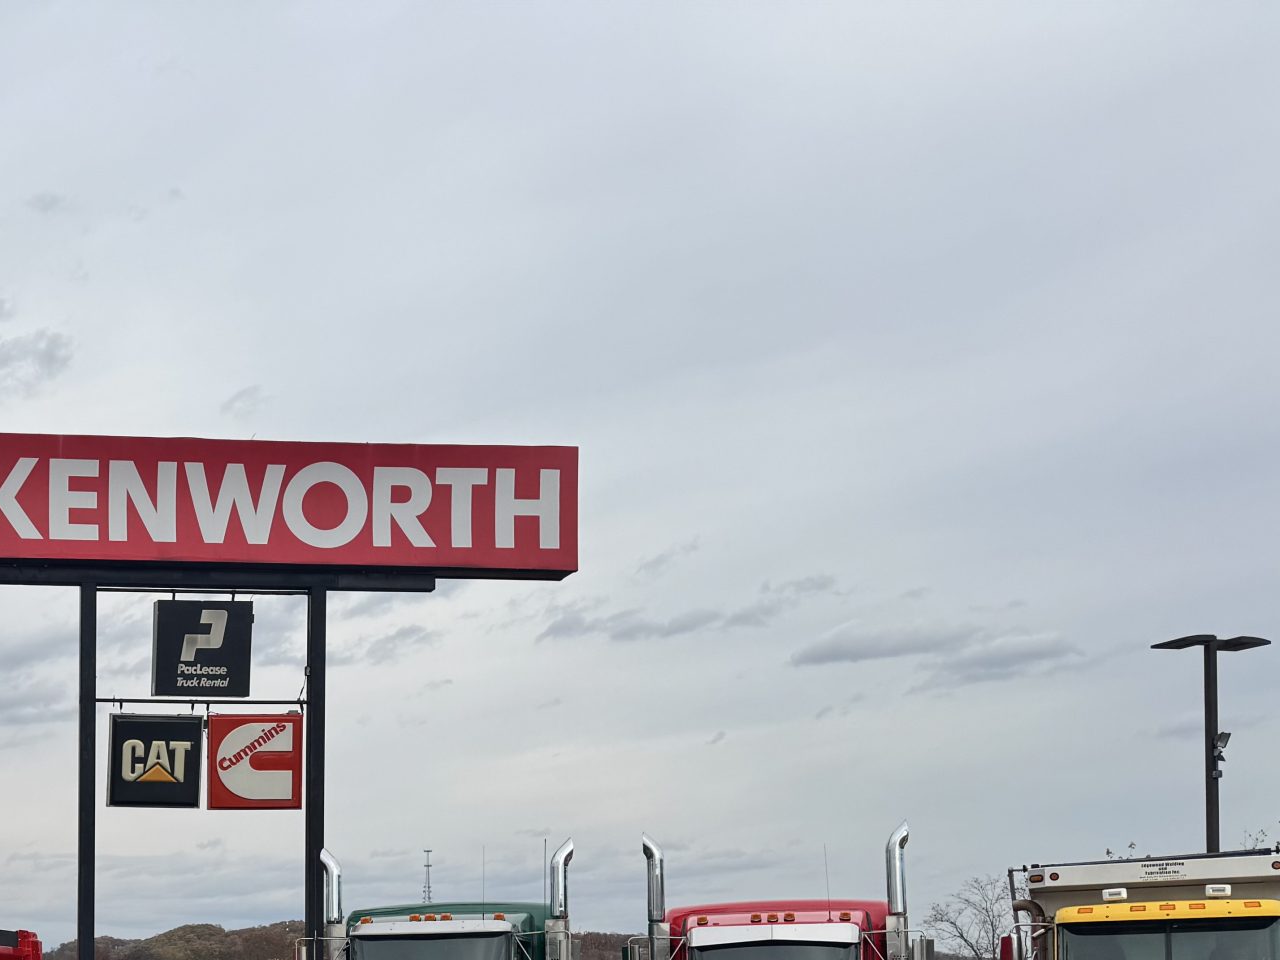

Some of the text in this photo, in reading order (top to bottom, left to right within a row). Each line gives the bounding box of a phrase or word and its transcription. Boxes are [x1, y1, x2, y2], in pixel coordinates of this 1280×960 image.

[176, 676, 230, 687] Truck Rental
[177, 663, 228, 675] PacLease
[218, 722, 287, 771] Cummins
[121, 739, 192, 783] CAT
